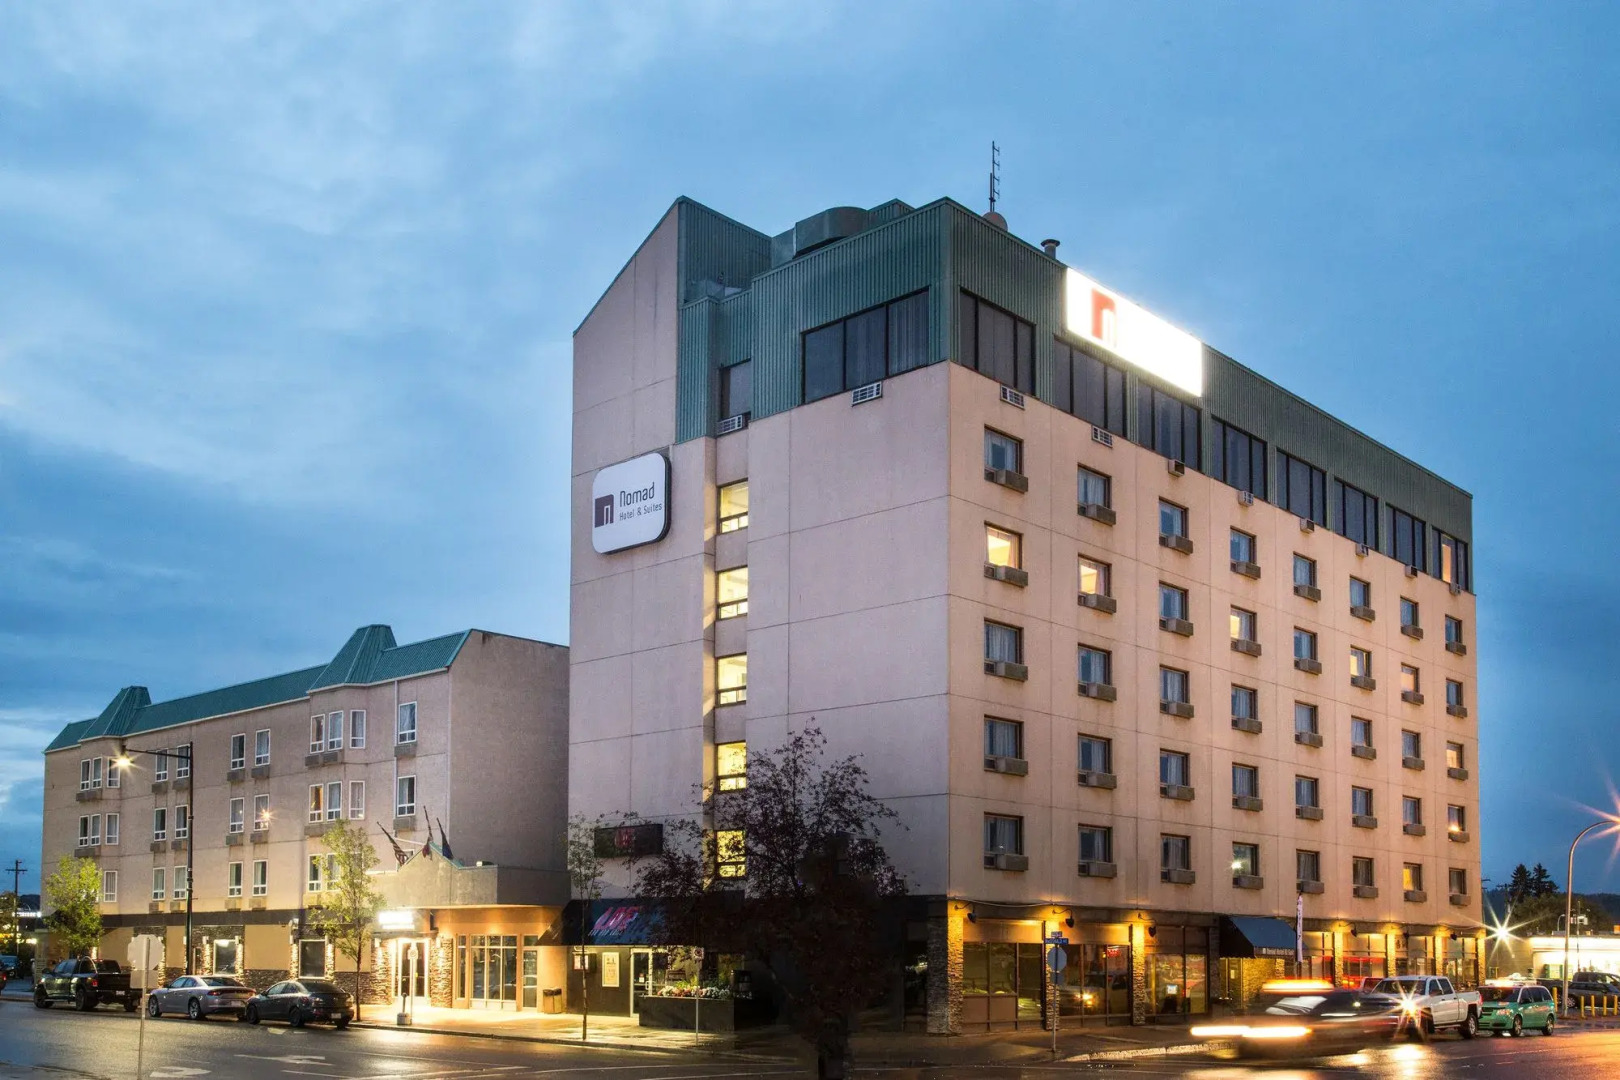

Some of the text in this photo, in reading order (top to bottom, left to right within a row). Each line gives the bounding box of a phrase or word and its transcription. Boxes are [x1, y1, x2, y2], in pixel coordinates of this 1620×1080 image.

[619, 503, 663, 521] Hotel & Suites
